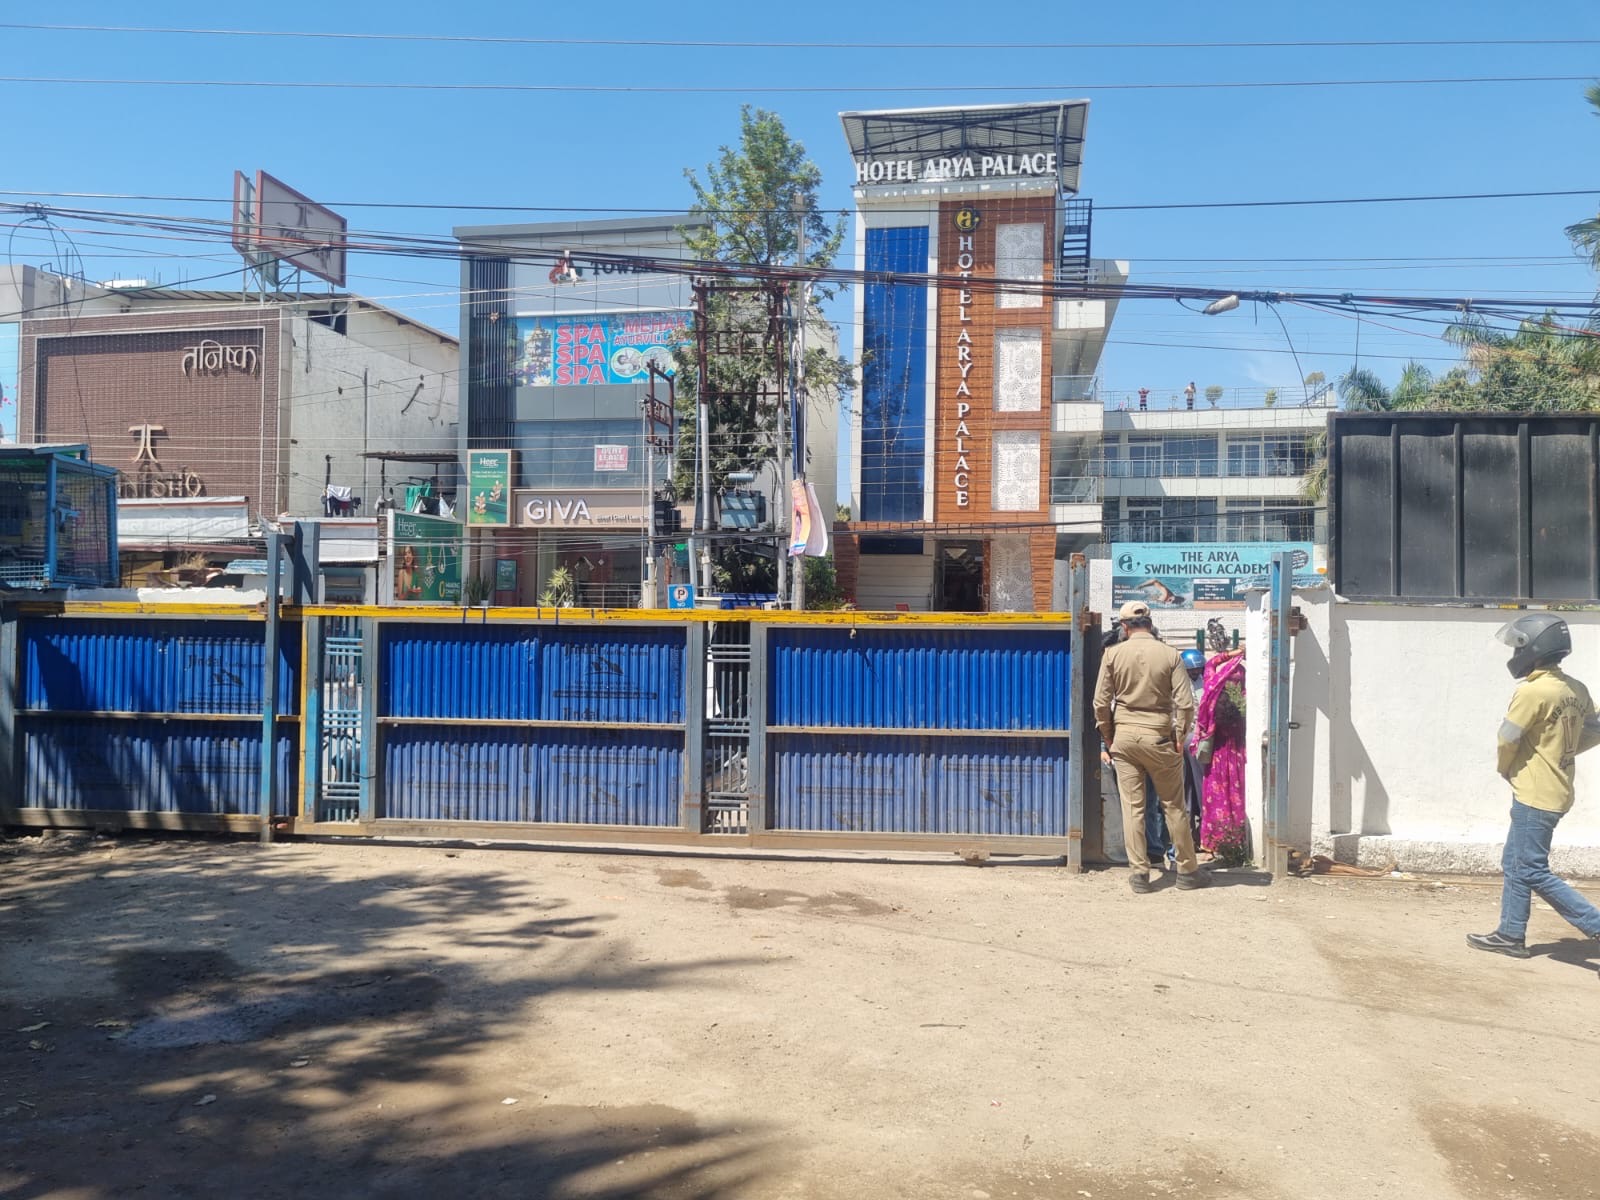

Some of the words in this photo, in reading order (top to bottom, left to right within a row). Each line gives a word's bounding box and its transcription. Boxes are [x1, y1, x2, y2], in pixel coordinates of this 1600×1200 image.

[856, 161, 917, 182] HOTEL
[923, 156, 975, 178] ARYA
[982, 152, 1057, 177] PALACE
[556, 324, 606, 343] SPA
[624, 316, 687, 333] MEHAK
[614, 332, 668, 345] AYURVILL
[182, 339, 259, 376] तनिष्क
[556, 344, 606, 364] SPA
[956, 328, 972, 396] ARYA
[556, 364, 606, 385] SPA
[954, 402, 971, 507] PALACE
[526, 499, 592, 521] GIVA
[1181, 552, 1204, 562] THE
[1208, 551, 1240, 562] ARYA
[1144, 563, 1212, 575] SWIMMING
